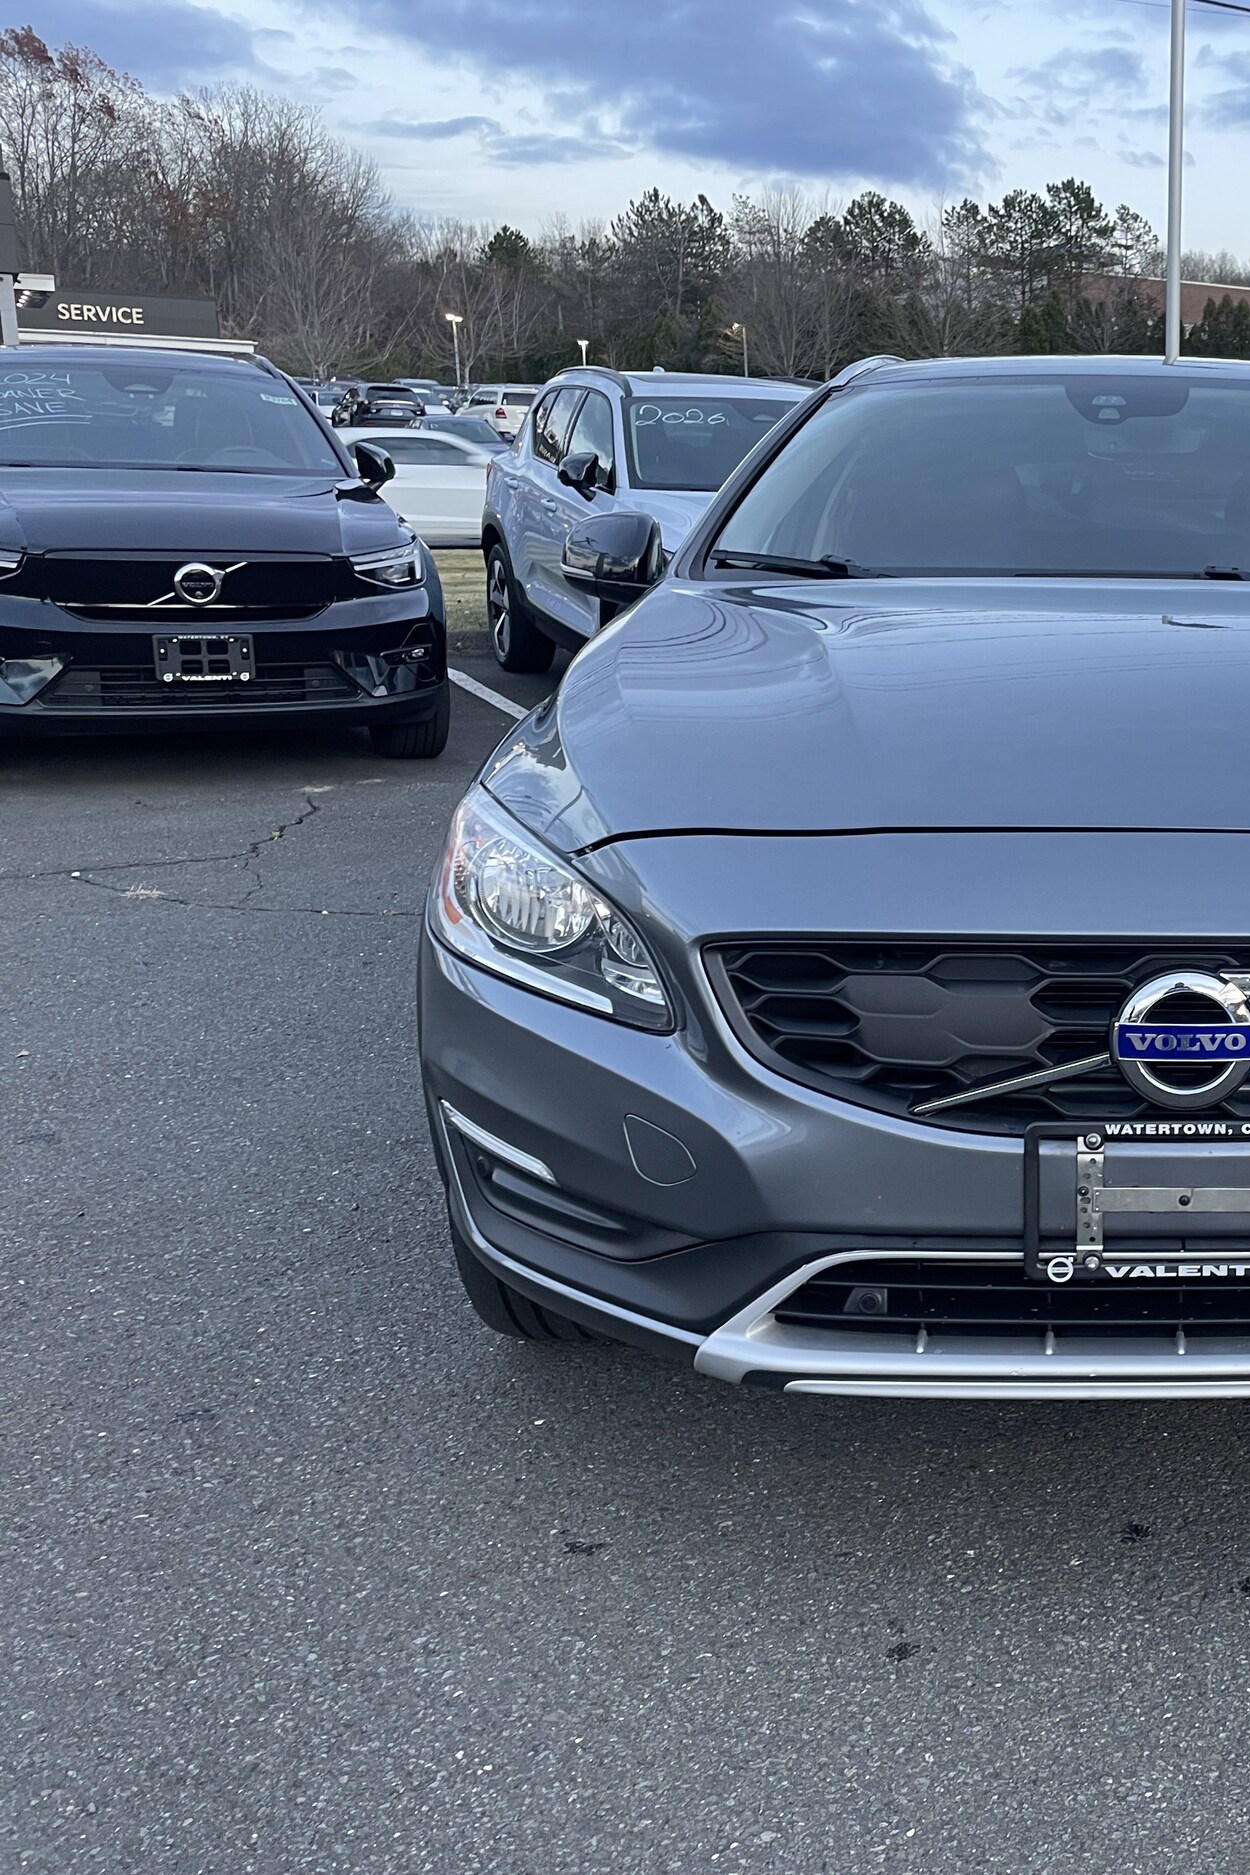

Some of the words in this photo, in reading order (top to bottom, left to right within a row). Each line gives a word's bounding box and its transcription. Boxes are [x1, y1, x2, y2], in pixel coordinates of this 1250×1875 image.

[57, 303, 145, 324] SERVICE
[0, 372, 71, 384] 024
[1125, 1032, 1247, 1051] VOLVO
[1104, 1123, 1234, 1136] WATERTOWN,
